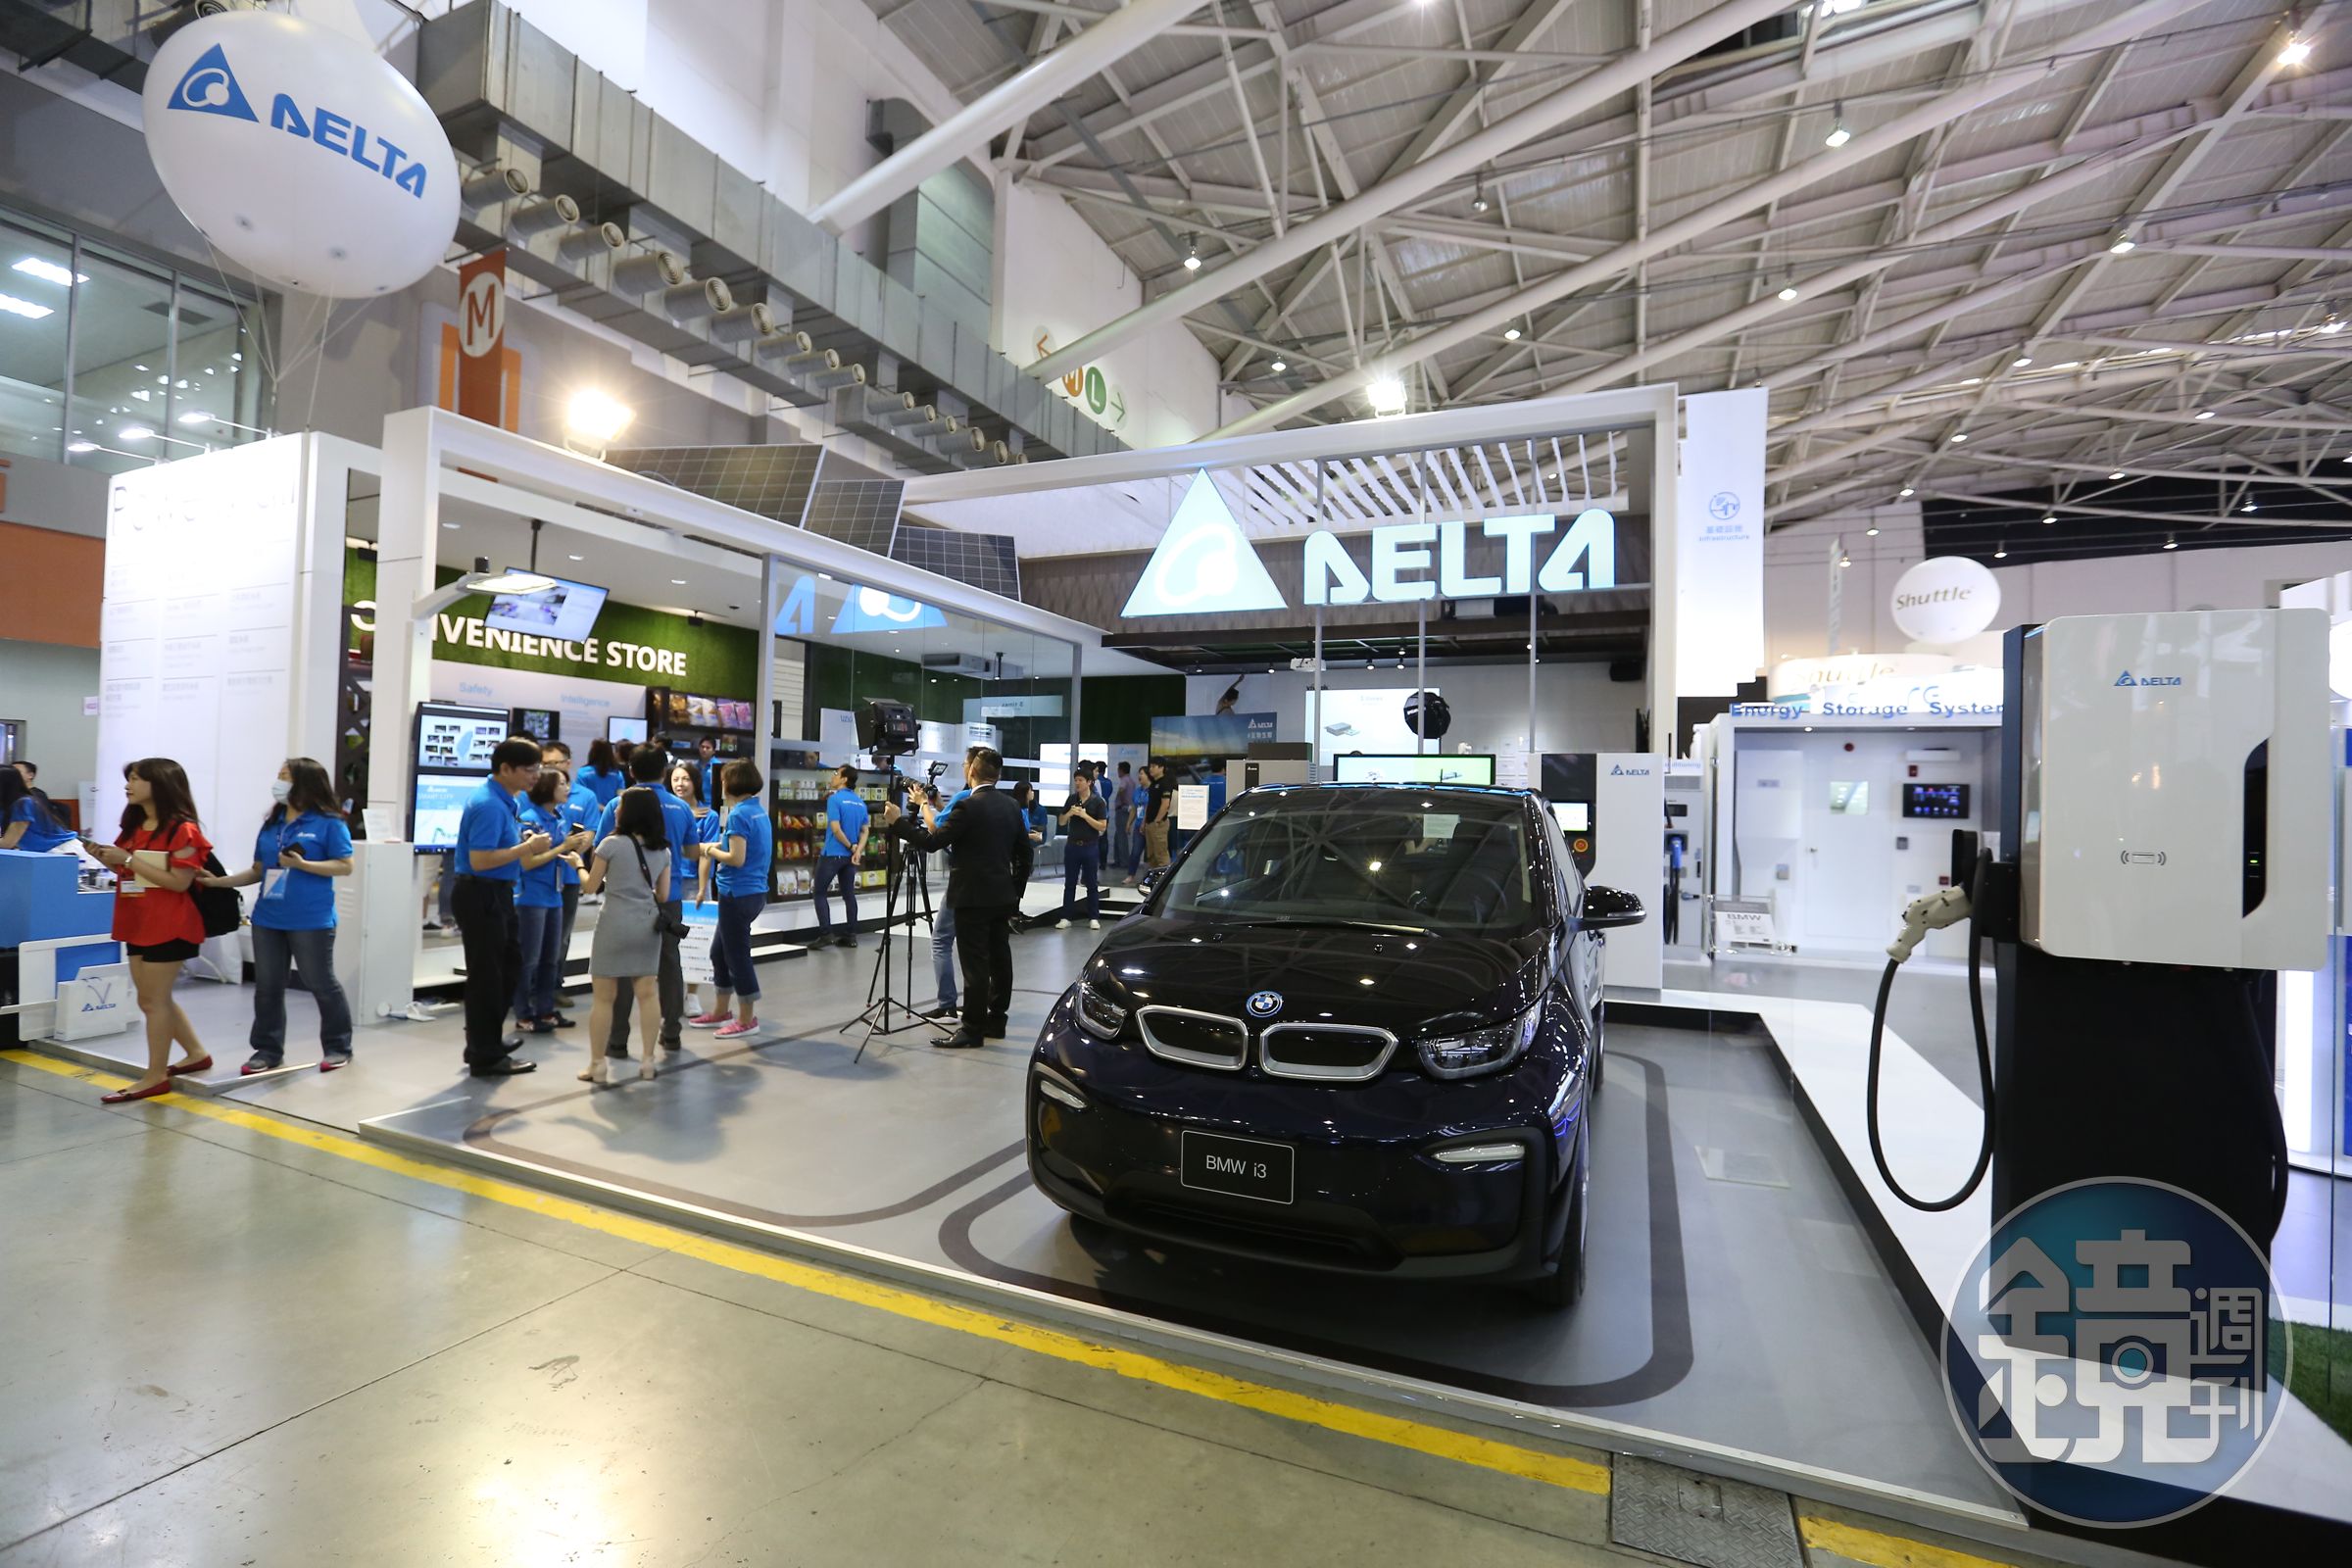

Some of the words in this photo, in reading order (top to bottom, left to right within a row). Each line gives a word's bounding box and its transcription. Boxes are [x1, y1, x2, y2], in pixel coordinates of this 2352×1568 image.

[270, 93, 427, 199] DELTA
[466, 283, 495, 346] M
[1303, 508, 1615, 606] DELTA
[1896, 587, 1972, 611] Shuttle
[606, 641, 687, 676] STORE
[2141, 677, 2181, 686] DELTA
[1730, 702, 1803, 719] Energy
[1822, 702, 1908, 719] Storage
[1205, 1154, 1247, 1175] BMW
[1253, 1162, 1267, 1179] i3
